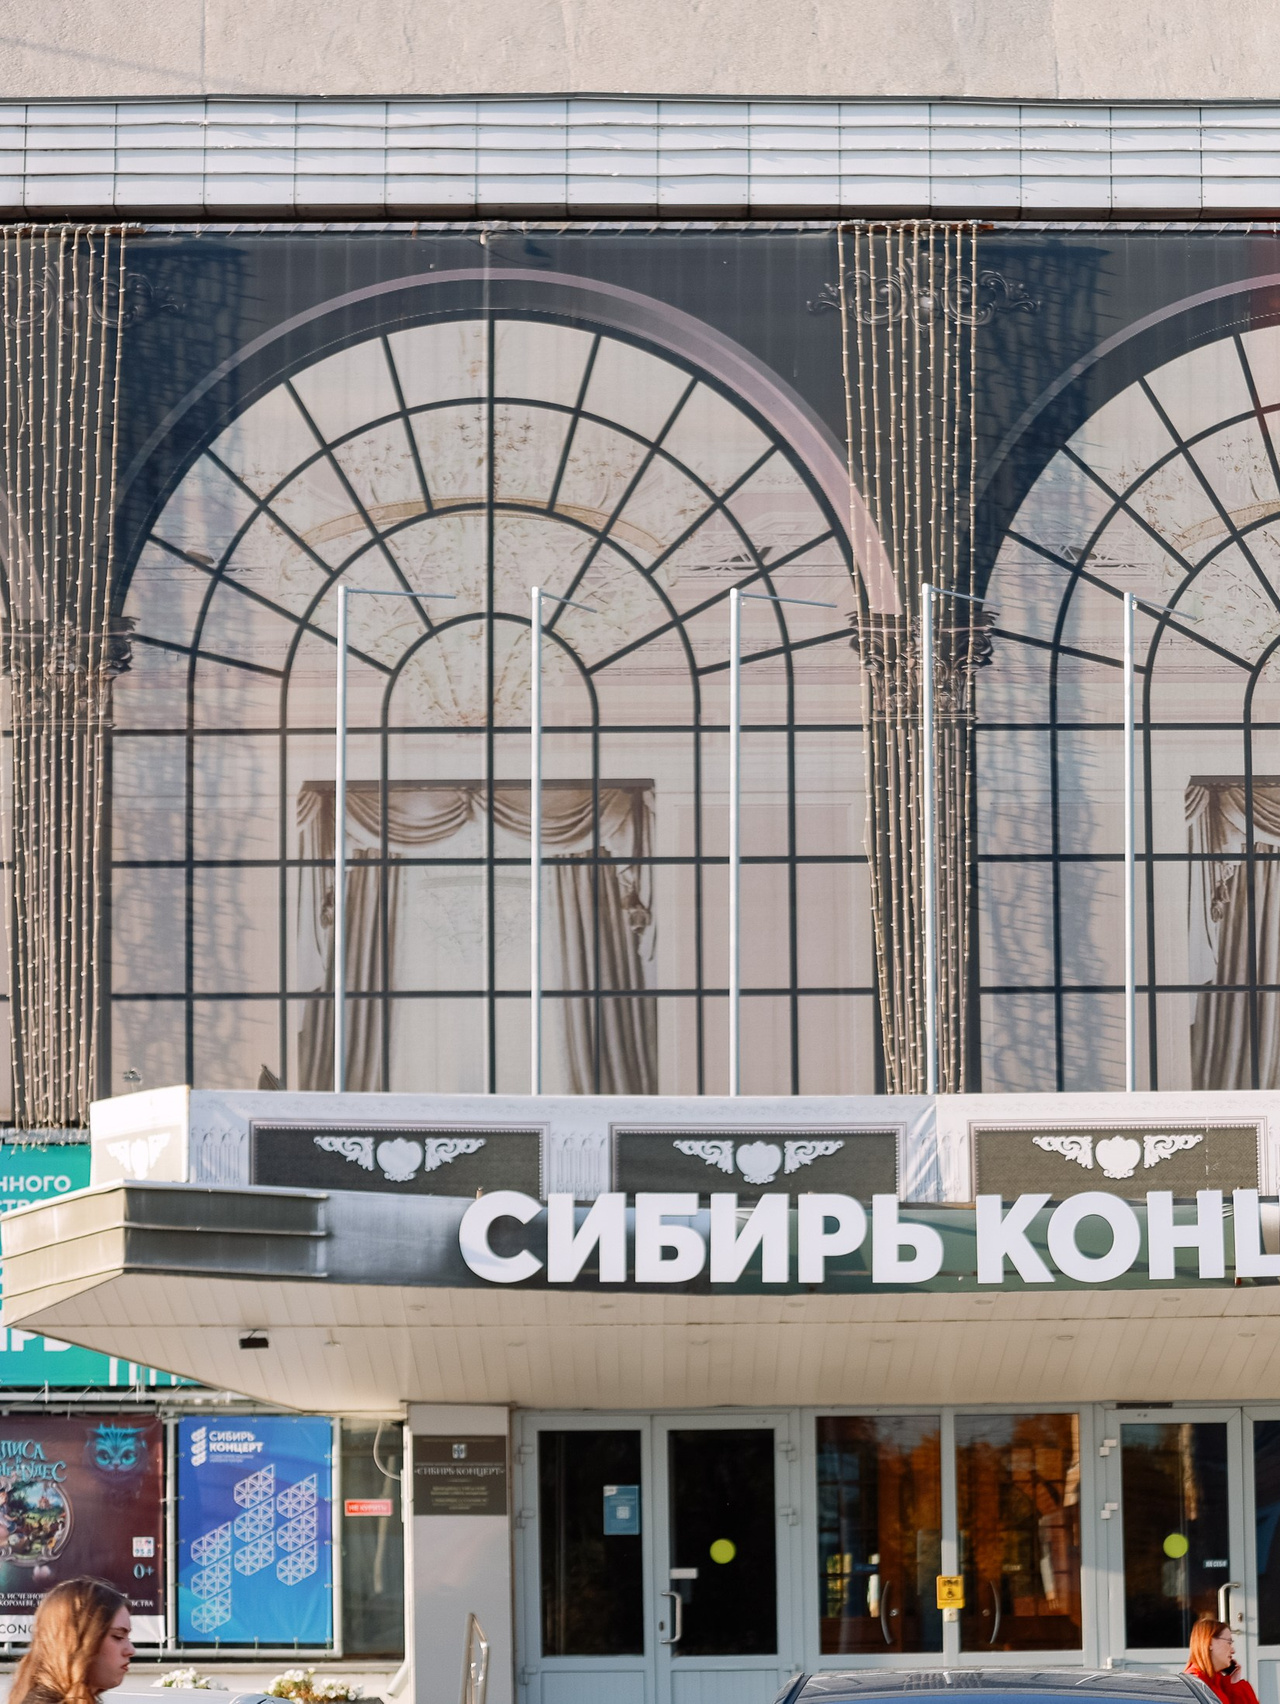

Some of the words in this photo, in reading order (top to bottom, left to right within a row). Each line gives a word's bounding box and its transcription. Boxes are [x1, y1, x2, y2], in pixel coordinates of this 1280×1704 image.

[459, 1190, 944, 1284] СИБИРЬ
[209, 1431, 256, 1442] СИБИРЬ
[209, 1442, 264, 1454] КОНЦЕРТ
